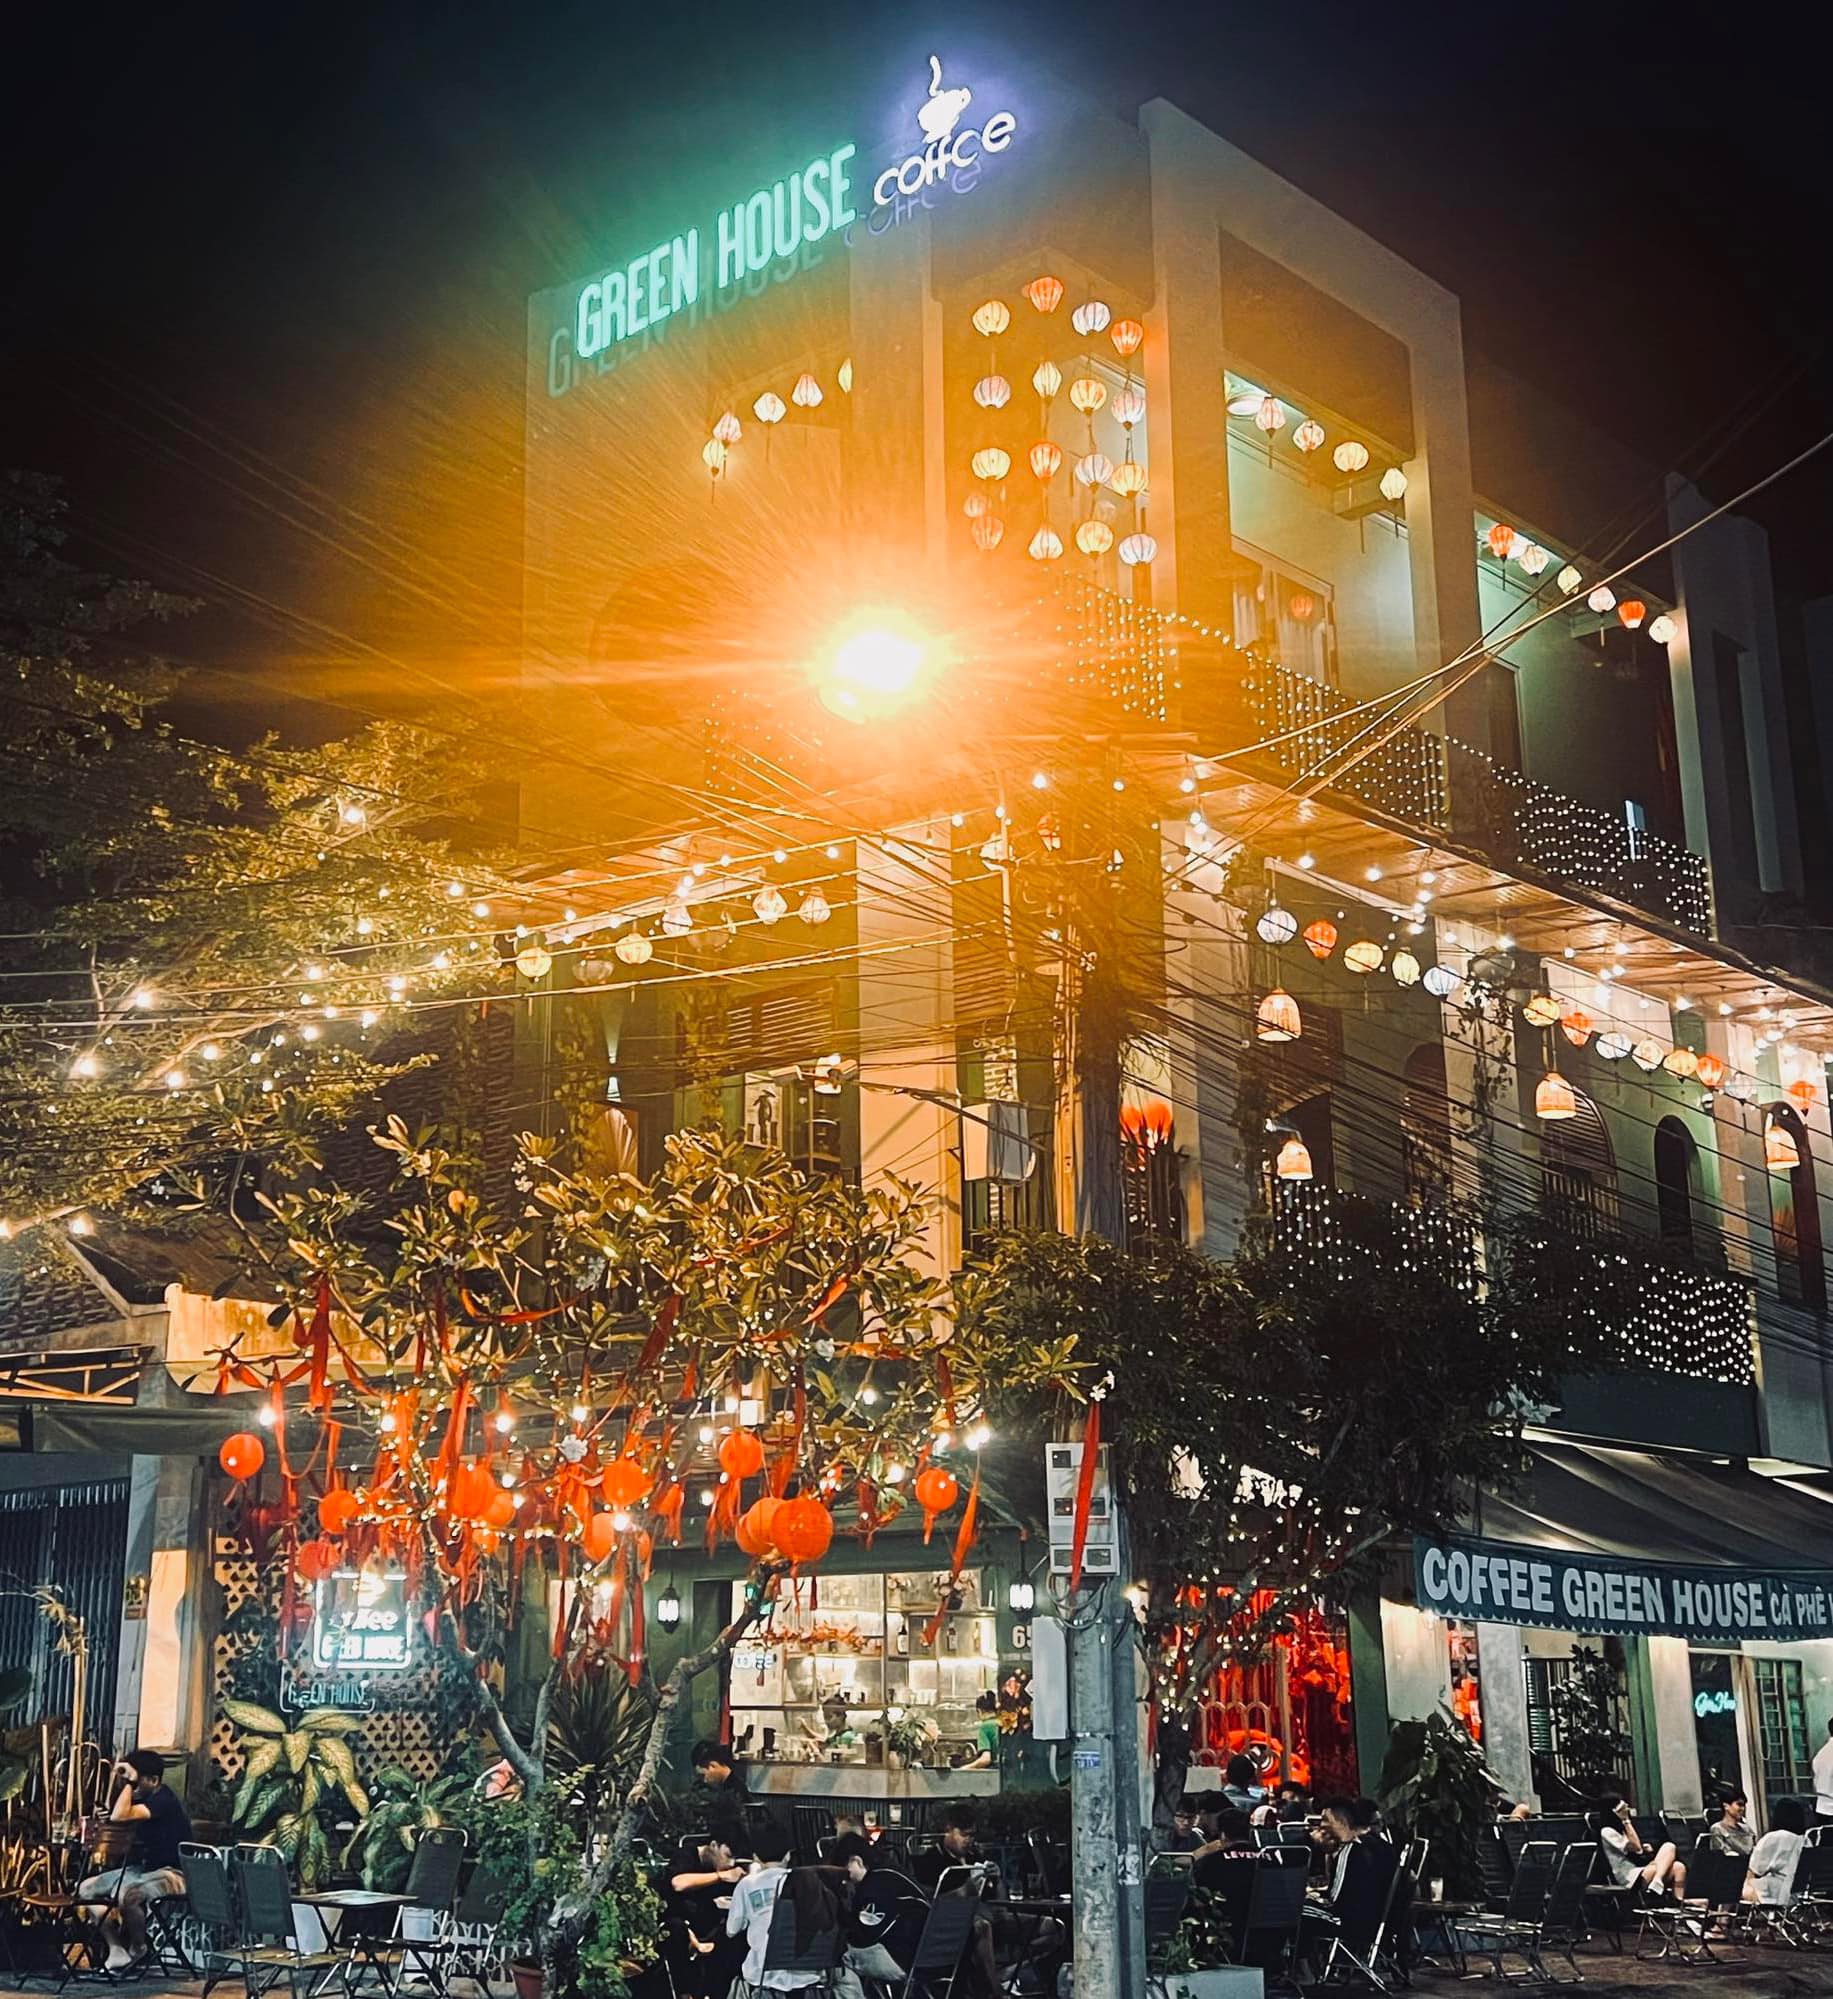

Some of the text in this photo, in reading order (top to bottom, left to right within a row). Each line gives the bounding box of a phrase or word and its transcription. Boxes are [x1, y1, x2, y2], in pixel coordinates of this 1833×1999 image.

[577, 143, 856, 358] GREEN HOUSE
[1423, 1547, 1554, 1613] COFFEE
[1562, 1568, 1665, 1624] GREEN
[1672, 1580, 1767, 1628] HOUSE
[1770, 1583, 1793, 1626] CÀ
[1795, 1585, 1827, 1626] PHÊ
